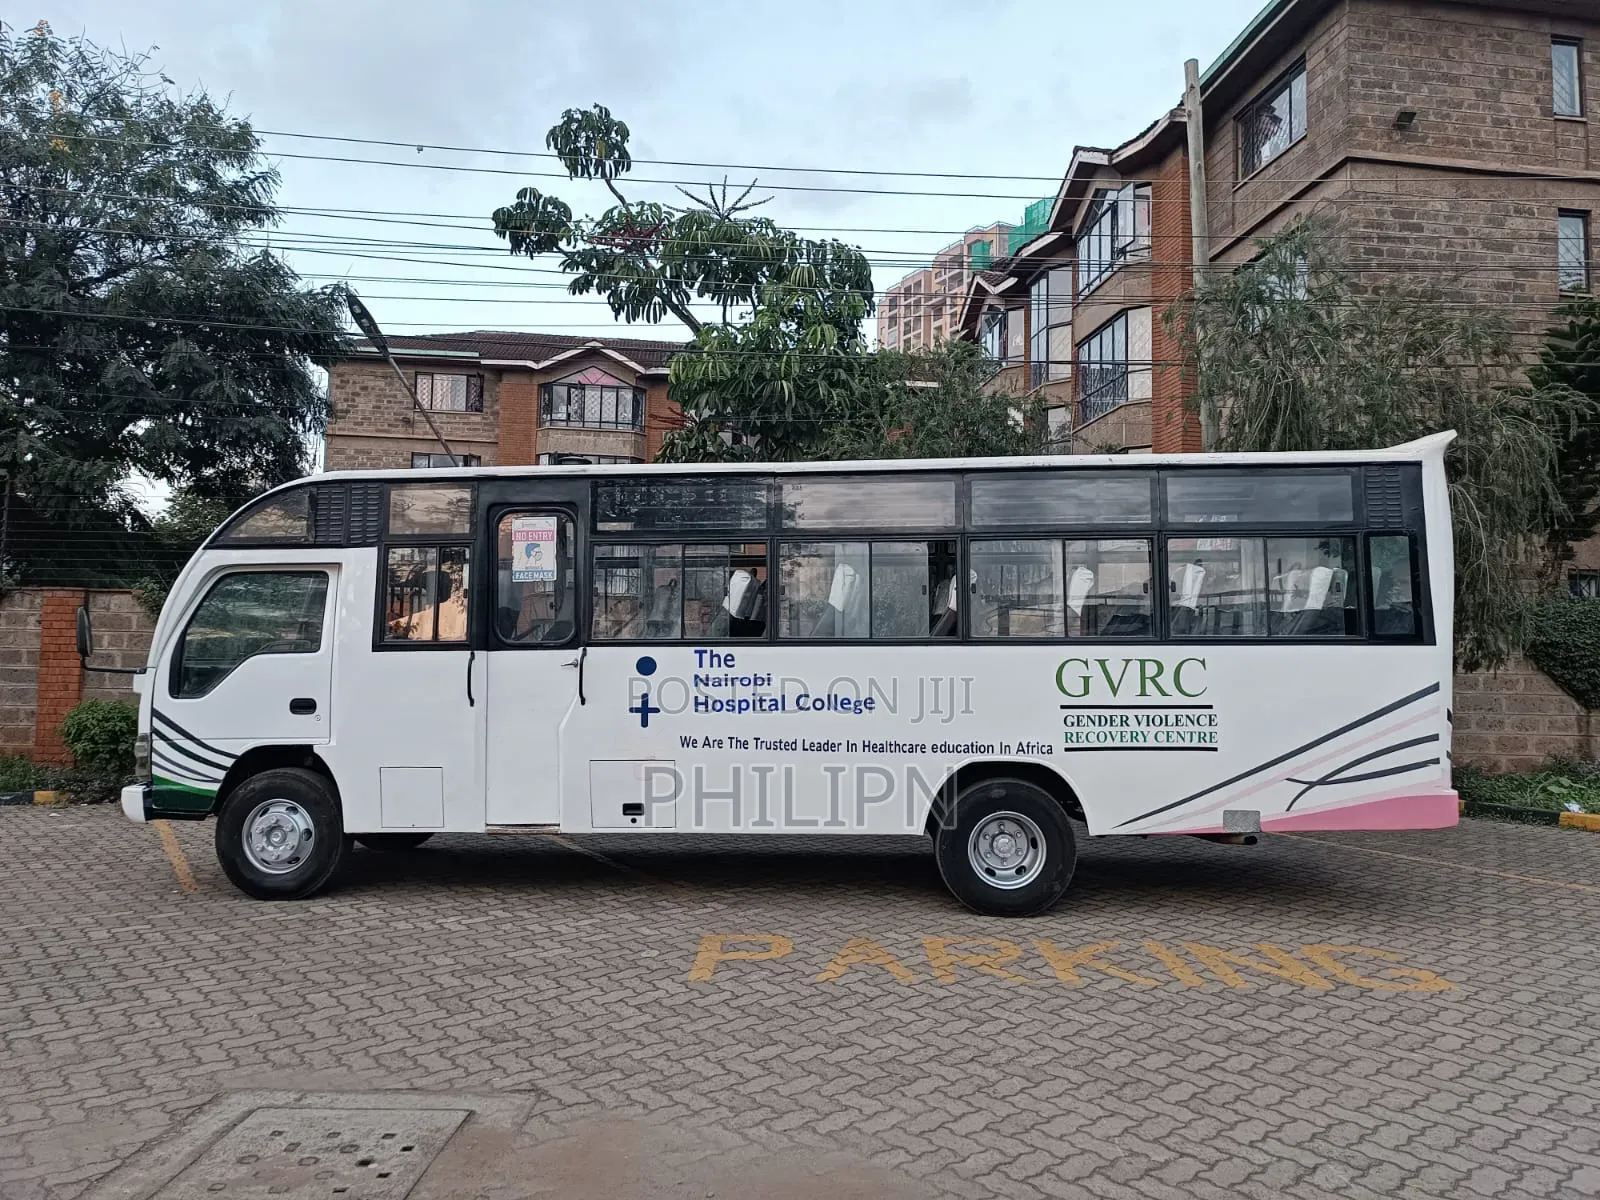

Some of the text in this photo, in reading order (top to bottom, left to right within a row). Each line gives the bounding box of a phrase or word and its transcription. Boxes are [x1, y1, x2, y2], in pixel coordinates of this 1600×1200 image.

[515, 531, 553, 541] NO ENTRY
[694, 649, 736, 668] The
[693, 673, 772, 688] Nairobi
[1055, 657, 1208, 698] GVRC
[693, 693, 876, 715] Hospital College
[1063, 713, 1218, 728] GENDER VIOLENCE
[680, 735, 1053, 755] We Are The Trusted Leader In Healthcare education In Africa
[1063, 731, 1218, 744] RECOVERY CENTRE
[687, 934, 1457, 992] PARKING
